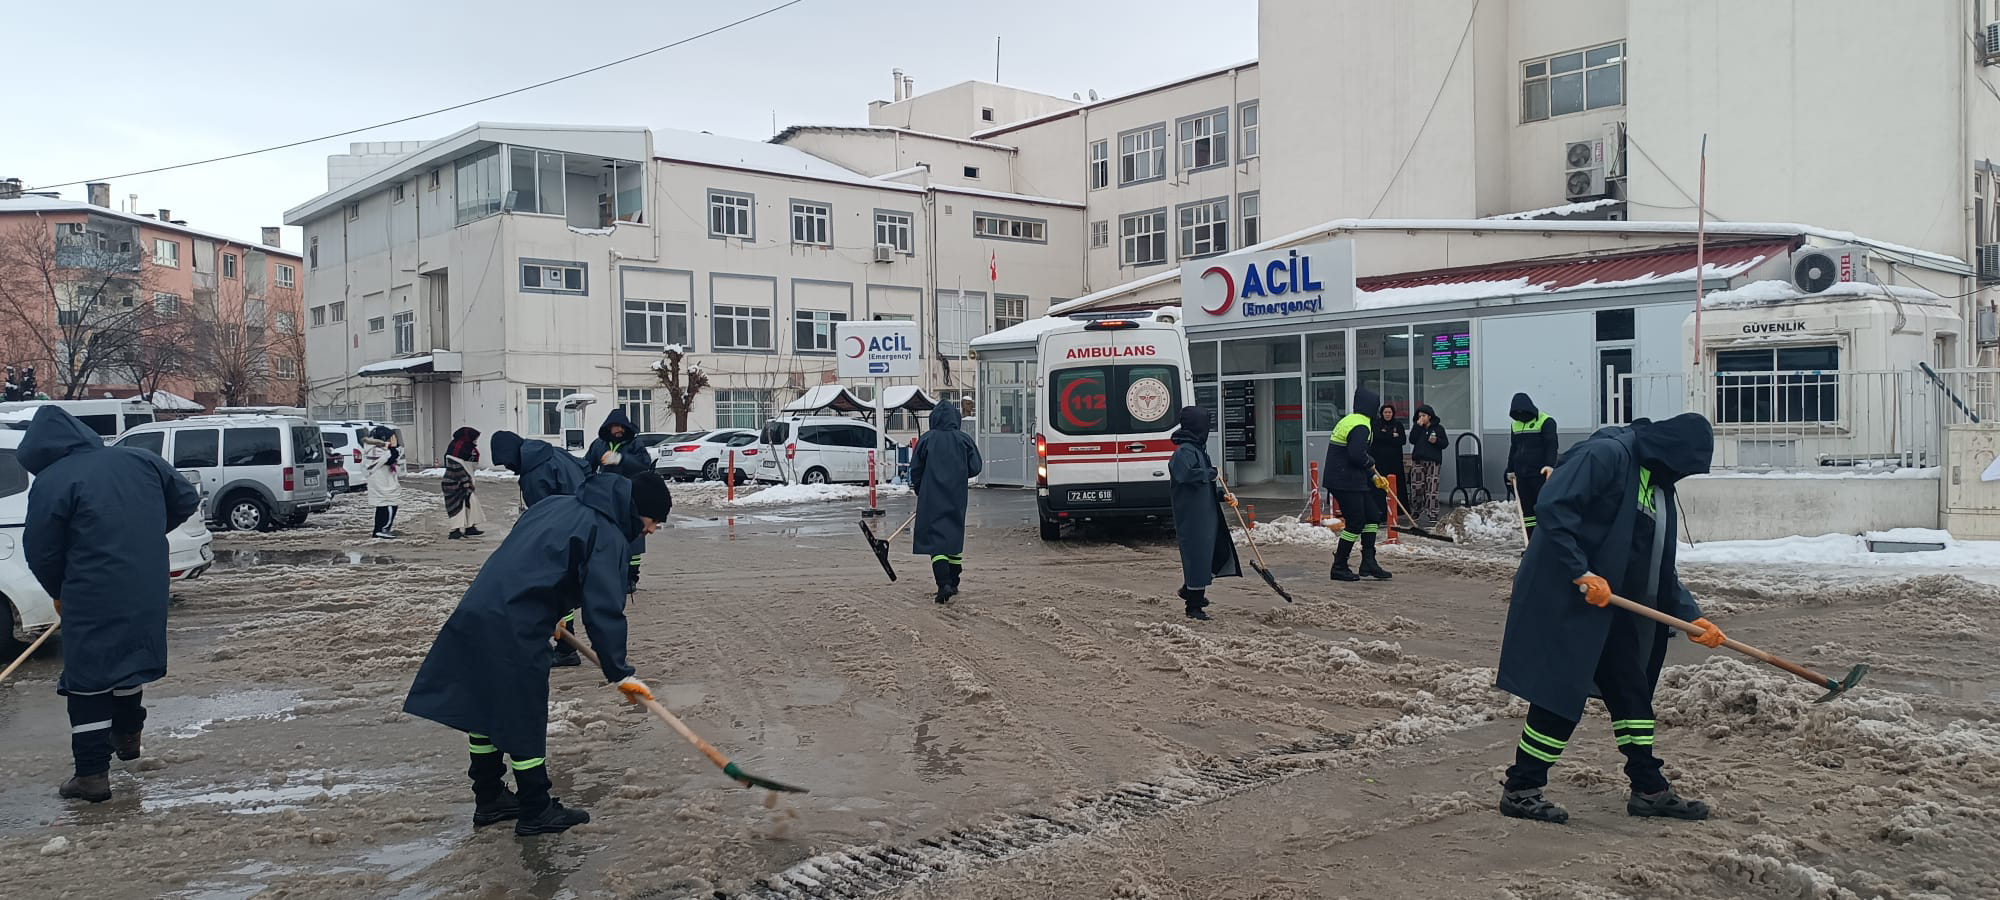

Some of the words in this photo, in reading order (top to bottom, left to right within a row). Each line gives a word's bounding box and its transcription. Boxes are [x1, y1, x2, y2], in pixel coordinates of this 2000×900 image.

[1241, 250, 1323, 298] ACİL
[1243, 295, 1322, 317] (Emergency)
[1742, 320, 1806, 334] GÜVENLİK
[868, 332, 912, 352] ACİL
[1066, 345, 1156, 359] AMBULANS
[1071, 394, 1106, 409] 112
[1071, 492, 1081, 500] 72
[1082, 491, 1096, 499] ACC
[1098, 491, 1112, 499] 618
